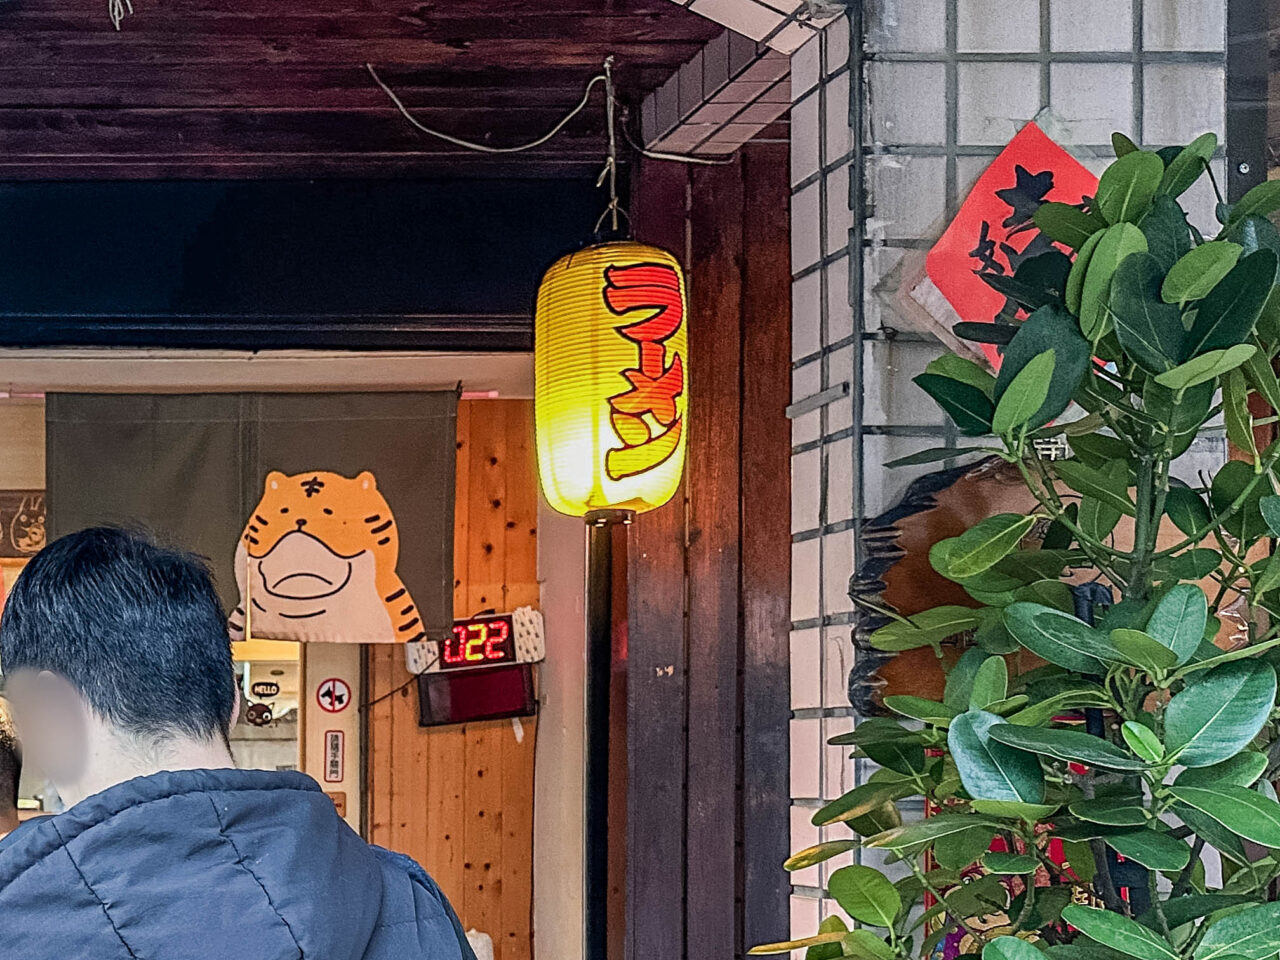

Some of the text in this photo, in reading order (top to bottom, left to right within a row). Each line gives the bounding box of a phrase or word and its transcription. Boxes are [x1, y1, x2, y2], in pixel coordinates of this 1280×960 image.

[603, 262, 683, 481] ラーメン
[254, 685, 278, 694] HELLO
